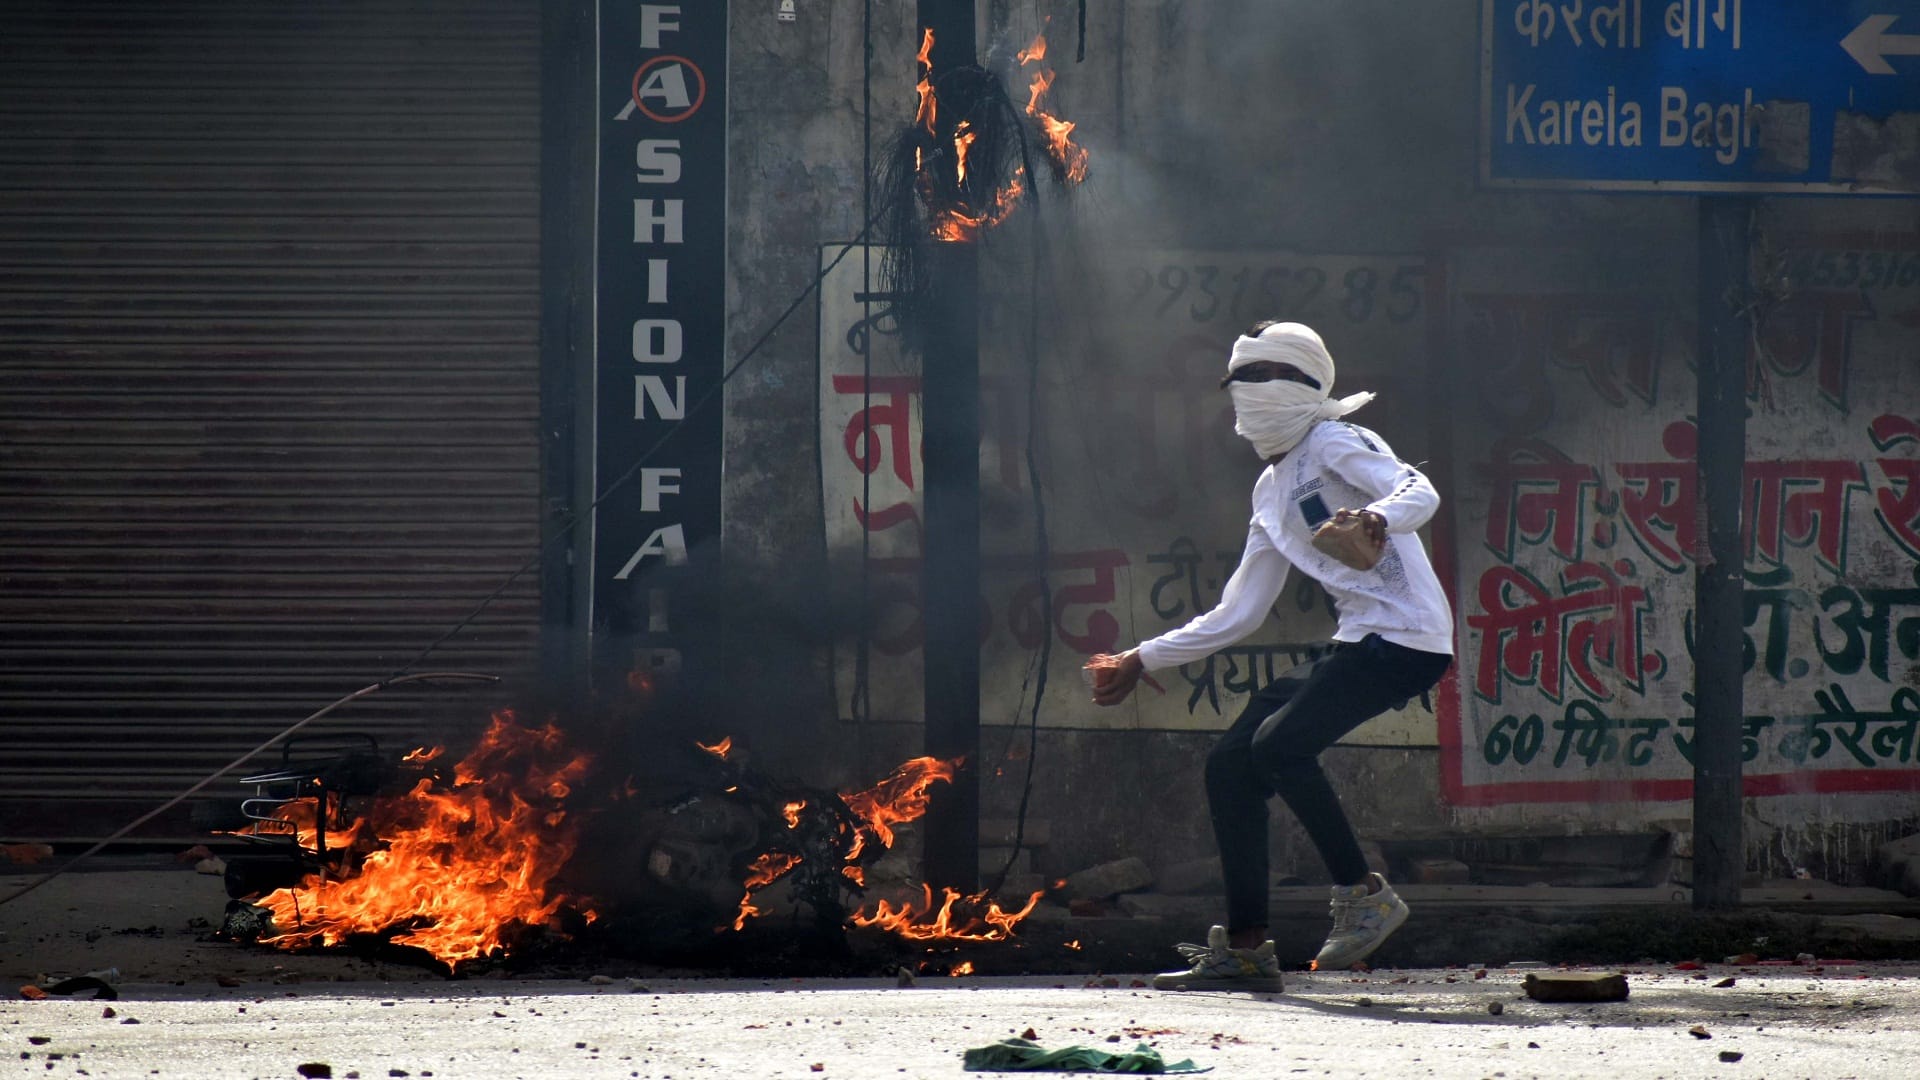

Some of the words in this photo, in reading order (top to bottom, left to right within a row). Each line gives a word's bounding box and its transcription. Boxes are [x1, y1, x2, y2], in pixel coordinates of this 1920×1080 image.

[1514, 0, 1642, 48] करला
[613, 4, 693, 420] FASHION
[1484, 714, 1545, 766] 60
